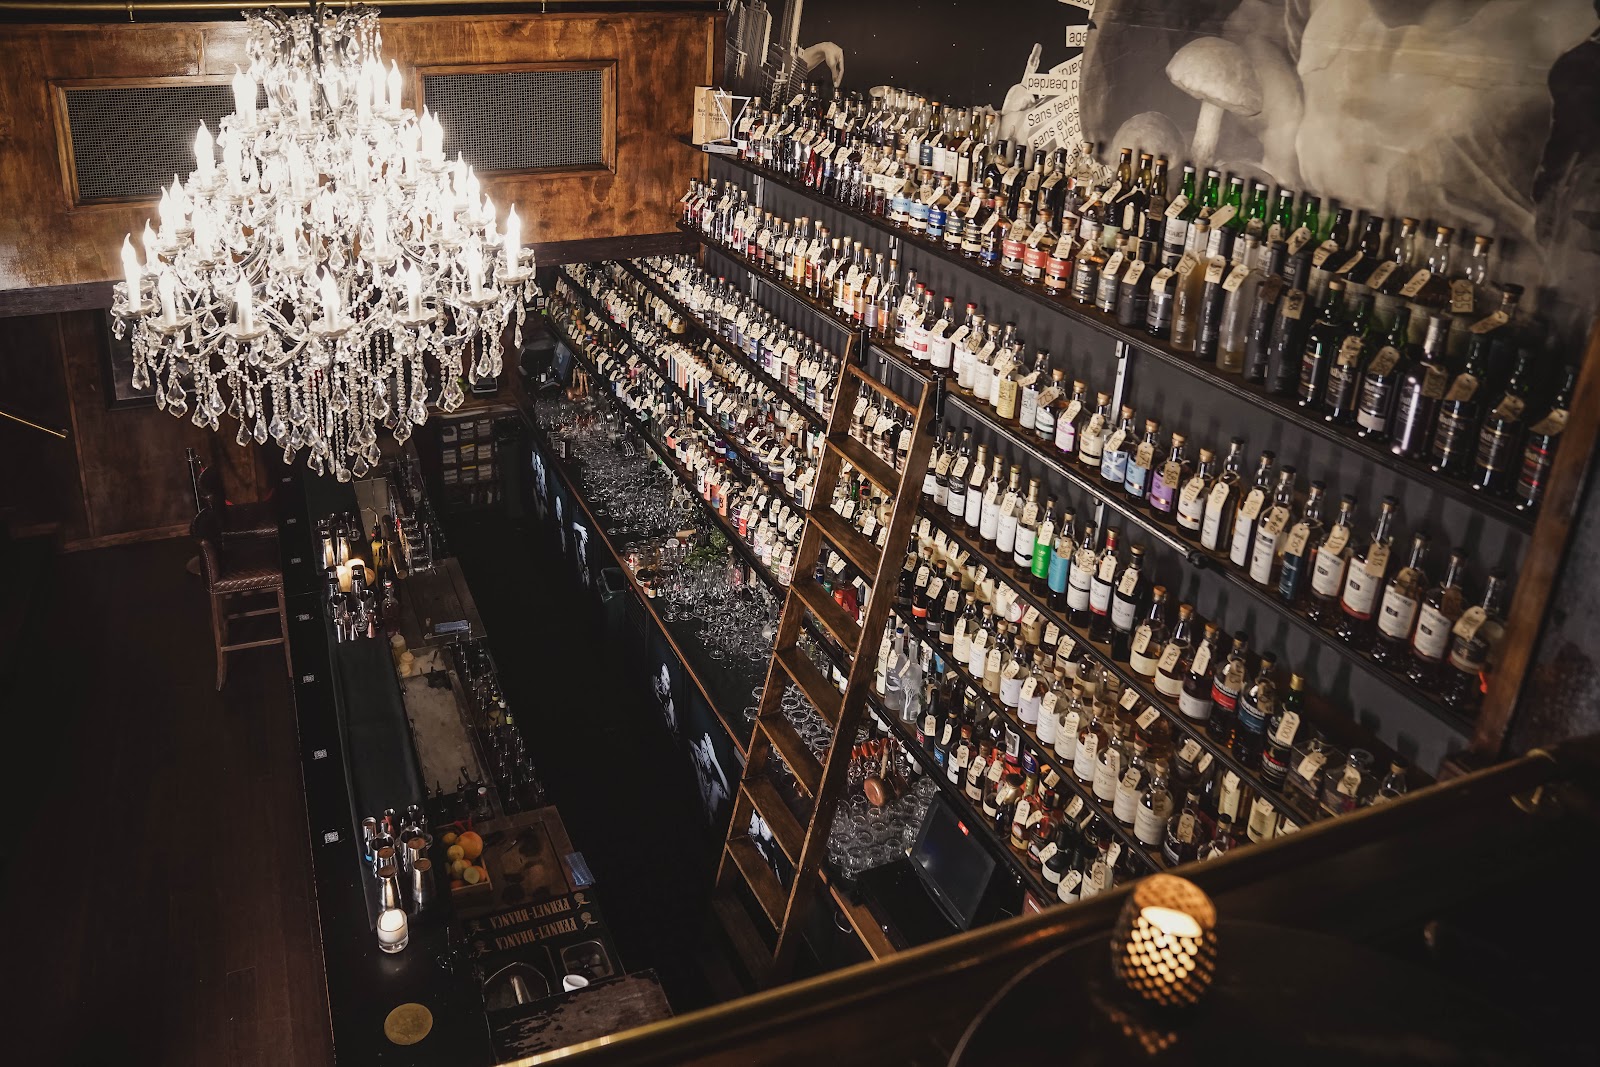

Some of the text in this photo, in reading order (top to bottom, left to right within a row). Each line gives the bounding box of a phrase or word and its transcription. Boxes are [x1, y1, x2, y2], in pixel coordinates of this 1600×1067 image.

[1029, 78, 1067, 92] bearded
[1028, 94, 1079, 127] Sans teeth
[1034, 128, 1055, 149] sans
[1137, 449, 1150, 467] $75
[1164, 469, 1177, 485] $85
[1162, 649, 1177, 667] $22
[1280, 719, 1294, 739] $100
[1092, 869, 1102, 884] $22
[490, 898, 571, 929] FERNET-BRANCA
[495, 917, 578, 950] FERNET-BRANCA
